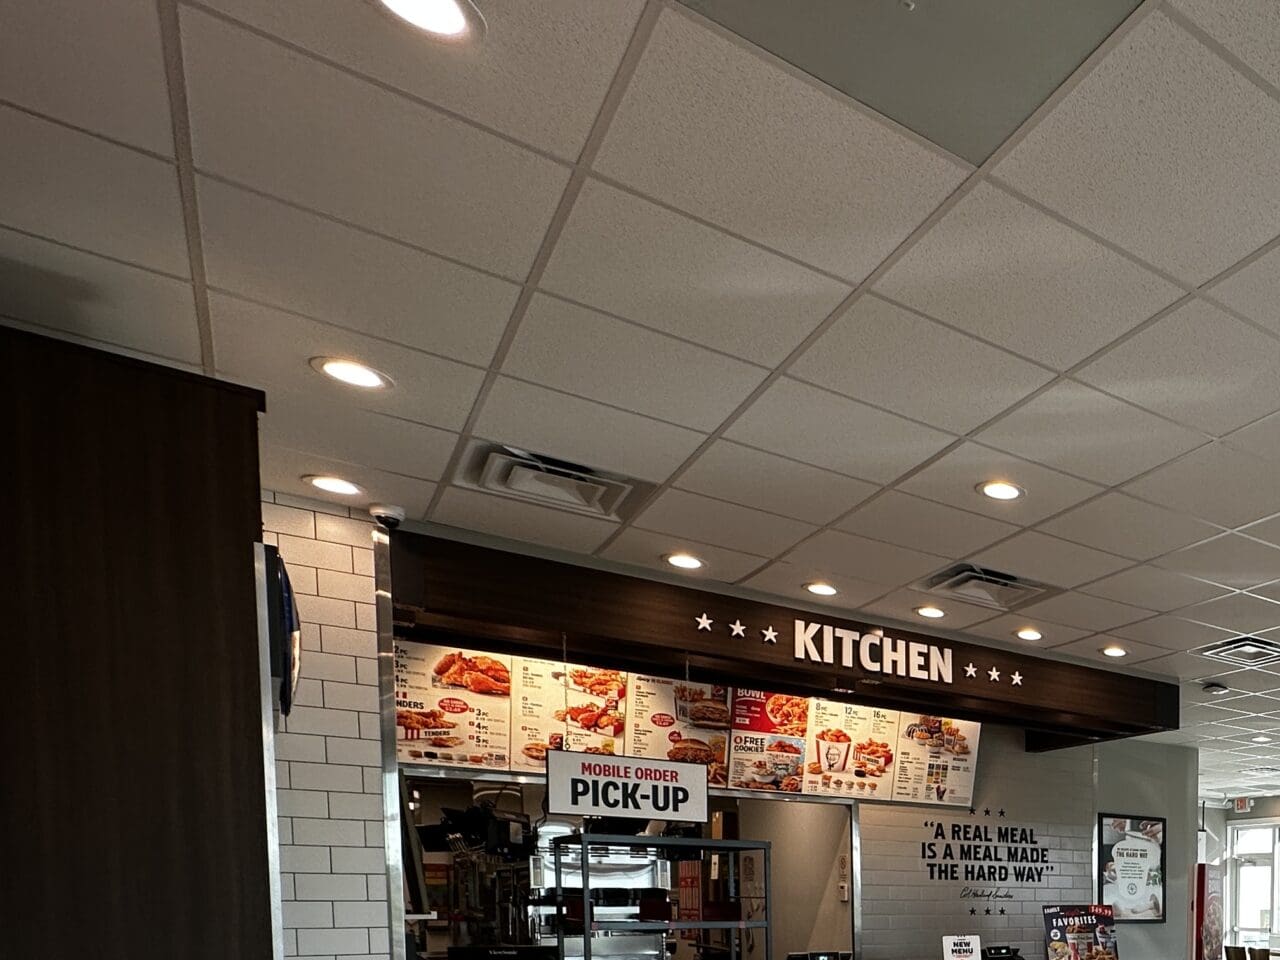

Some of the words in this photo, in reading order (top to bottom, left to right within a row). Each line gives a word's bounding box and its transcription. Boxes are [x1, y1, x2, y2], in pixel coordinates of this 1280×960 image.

[794, 619, 953, 684] KITCHEN
[396, 700, 424, 710] NDERS
[844, 706, 852, 714] 12
[734, 744, 764, 752] COOKIES
[744, 736, 766, 746] FREE
[581, 762, 631, 778] MOBILE
[634, 767, 679, 783] ORDER
[571, 778, 690, 812] PICK-UP
[951, 824, 992, 842] REAL
[998, 826, 1038, 844] MEAL
[922, 842, 937, 859] IS
[942, 843, 954, 860] A
[960, 844, 1003, 862] MEAL
[1007, 846, 1049, 864] MADE
[926, 863, 958, 880] THE
[964, 864, 1008, 882] HARD
[1052, 916, 1097, 926] FAVORITES
